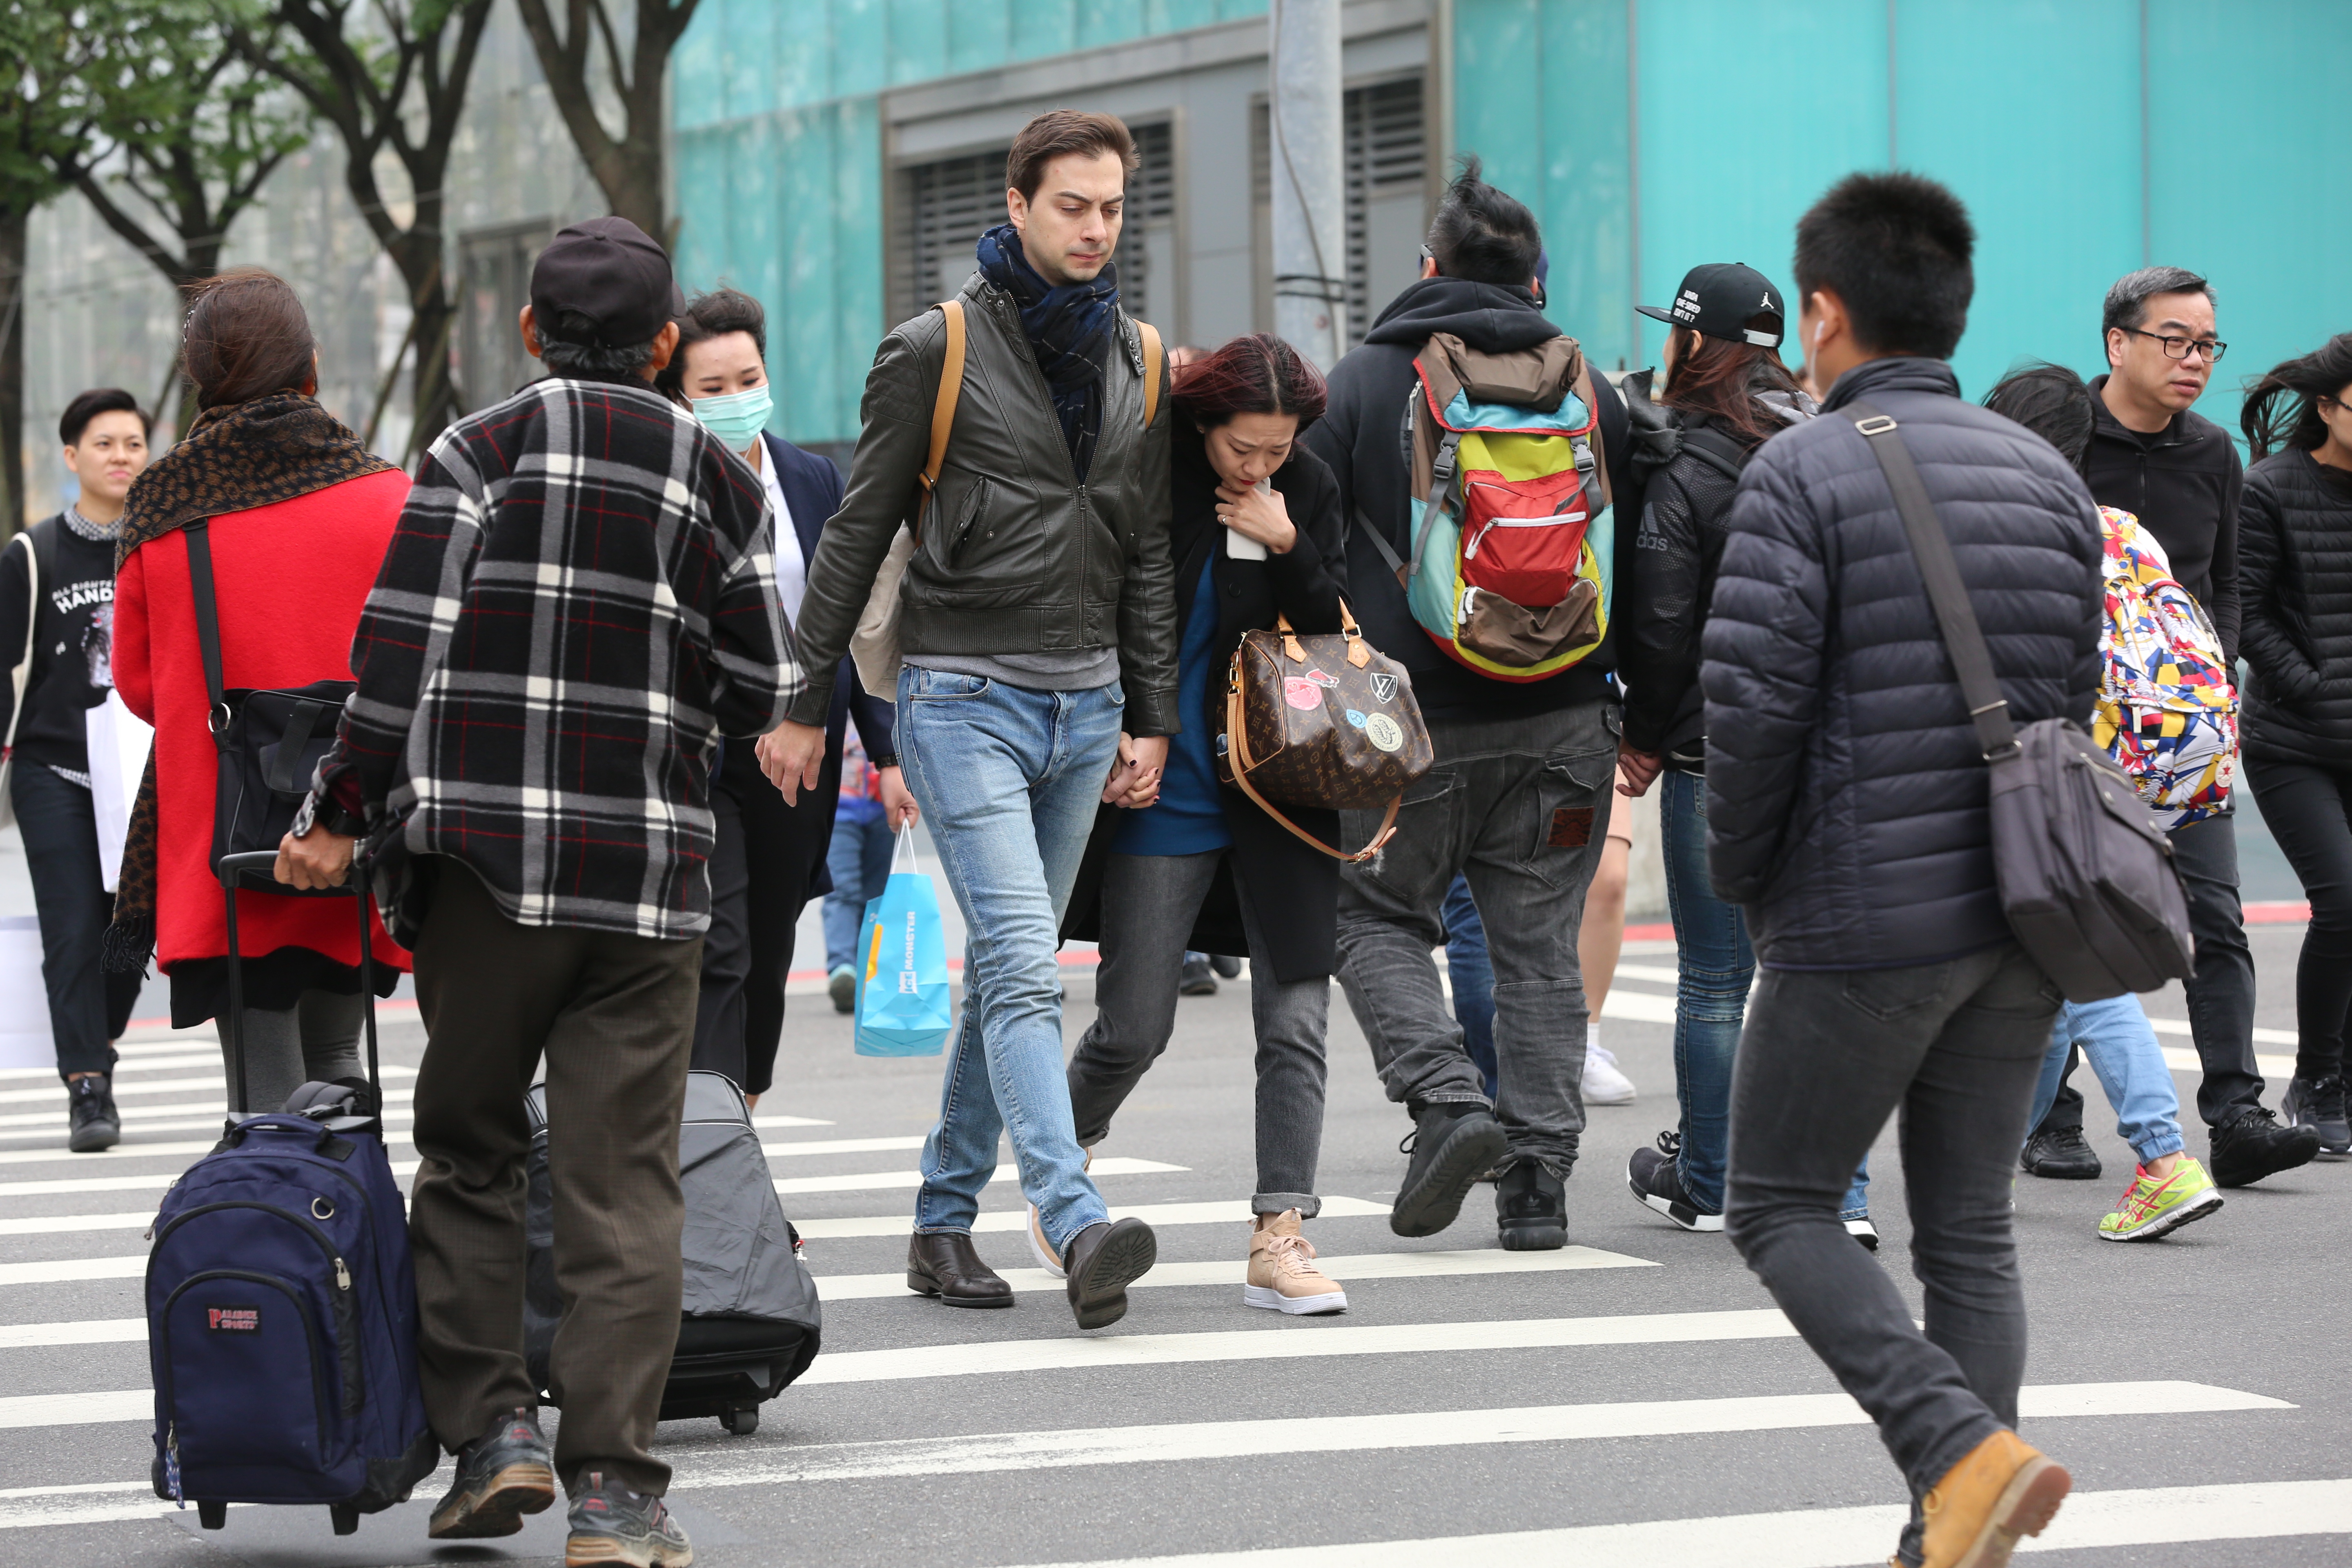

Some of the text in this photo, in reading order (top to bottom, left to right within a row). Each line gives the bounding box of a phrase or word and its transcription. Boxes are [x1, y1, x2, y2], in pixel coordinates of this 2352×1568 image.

[52, 586, 71, 601] ALL
[71, 580, 113, 592] RIGHTS
[904, 911, 915, 992] ICE MONSTER
